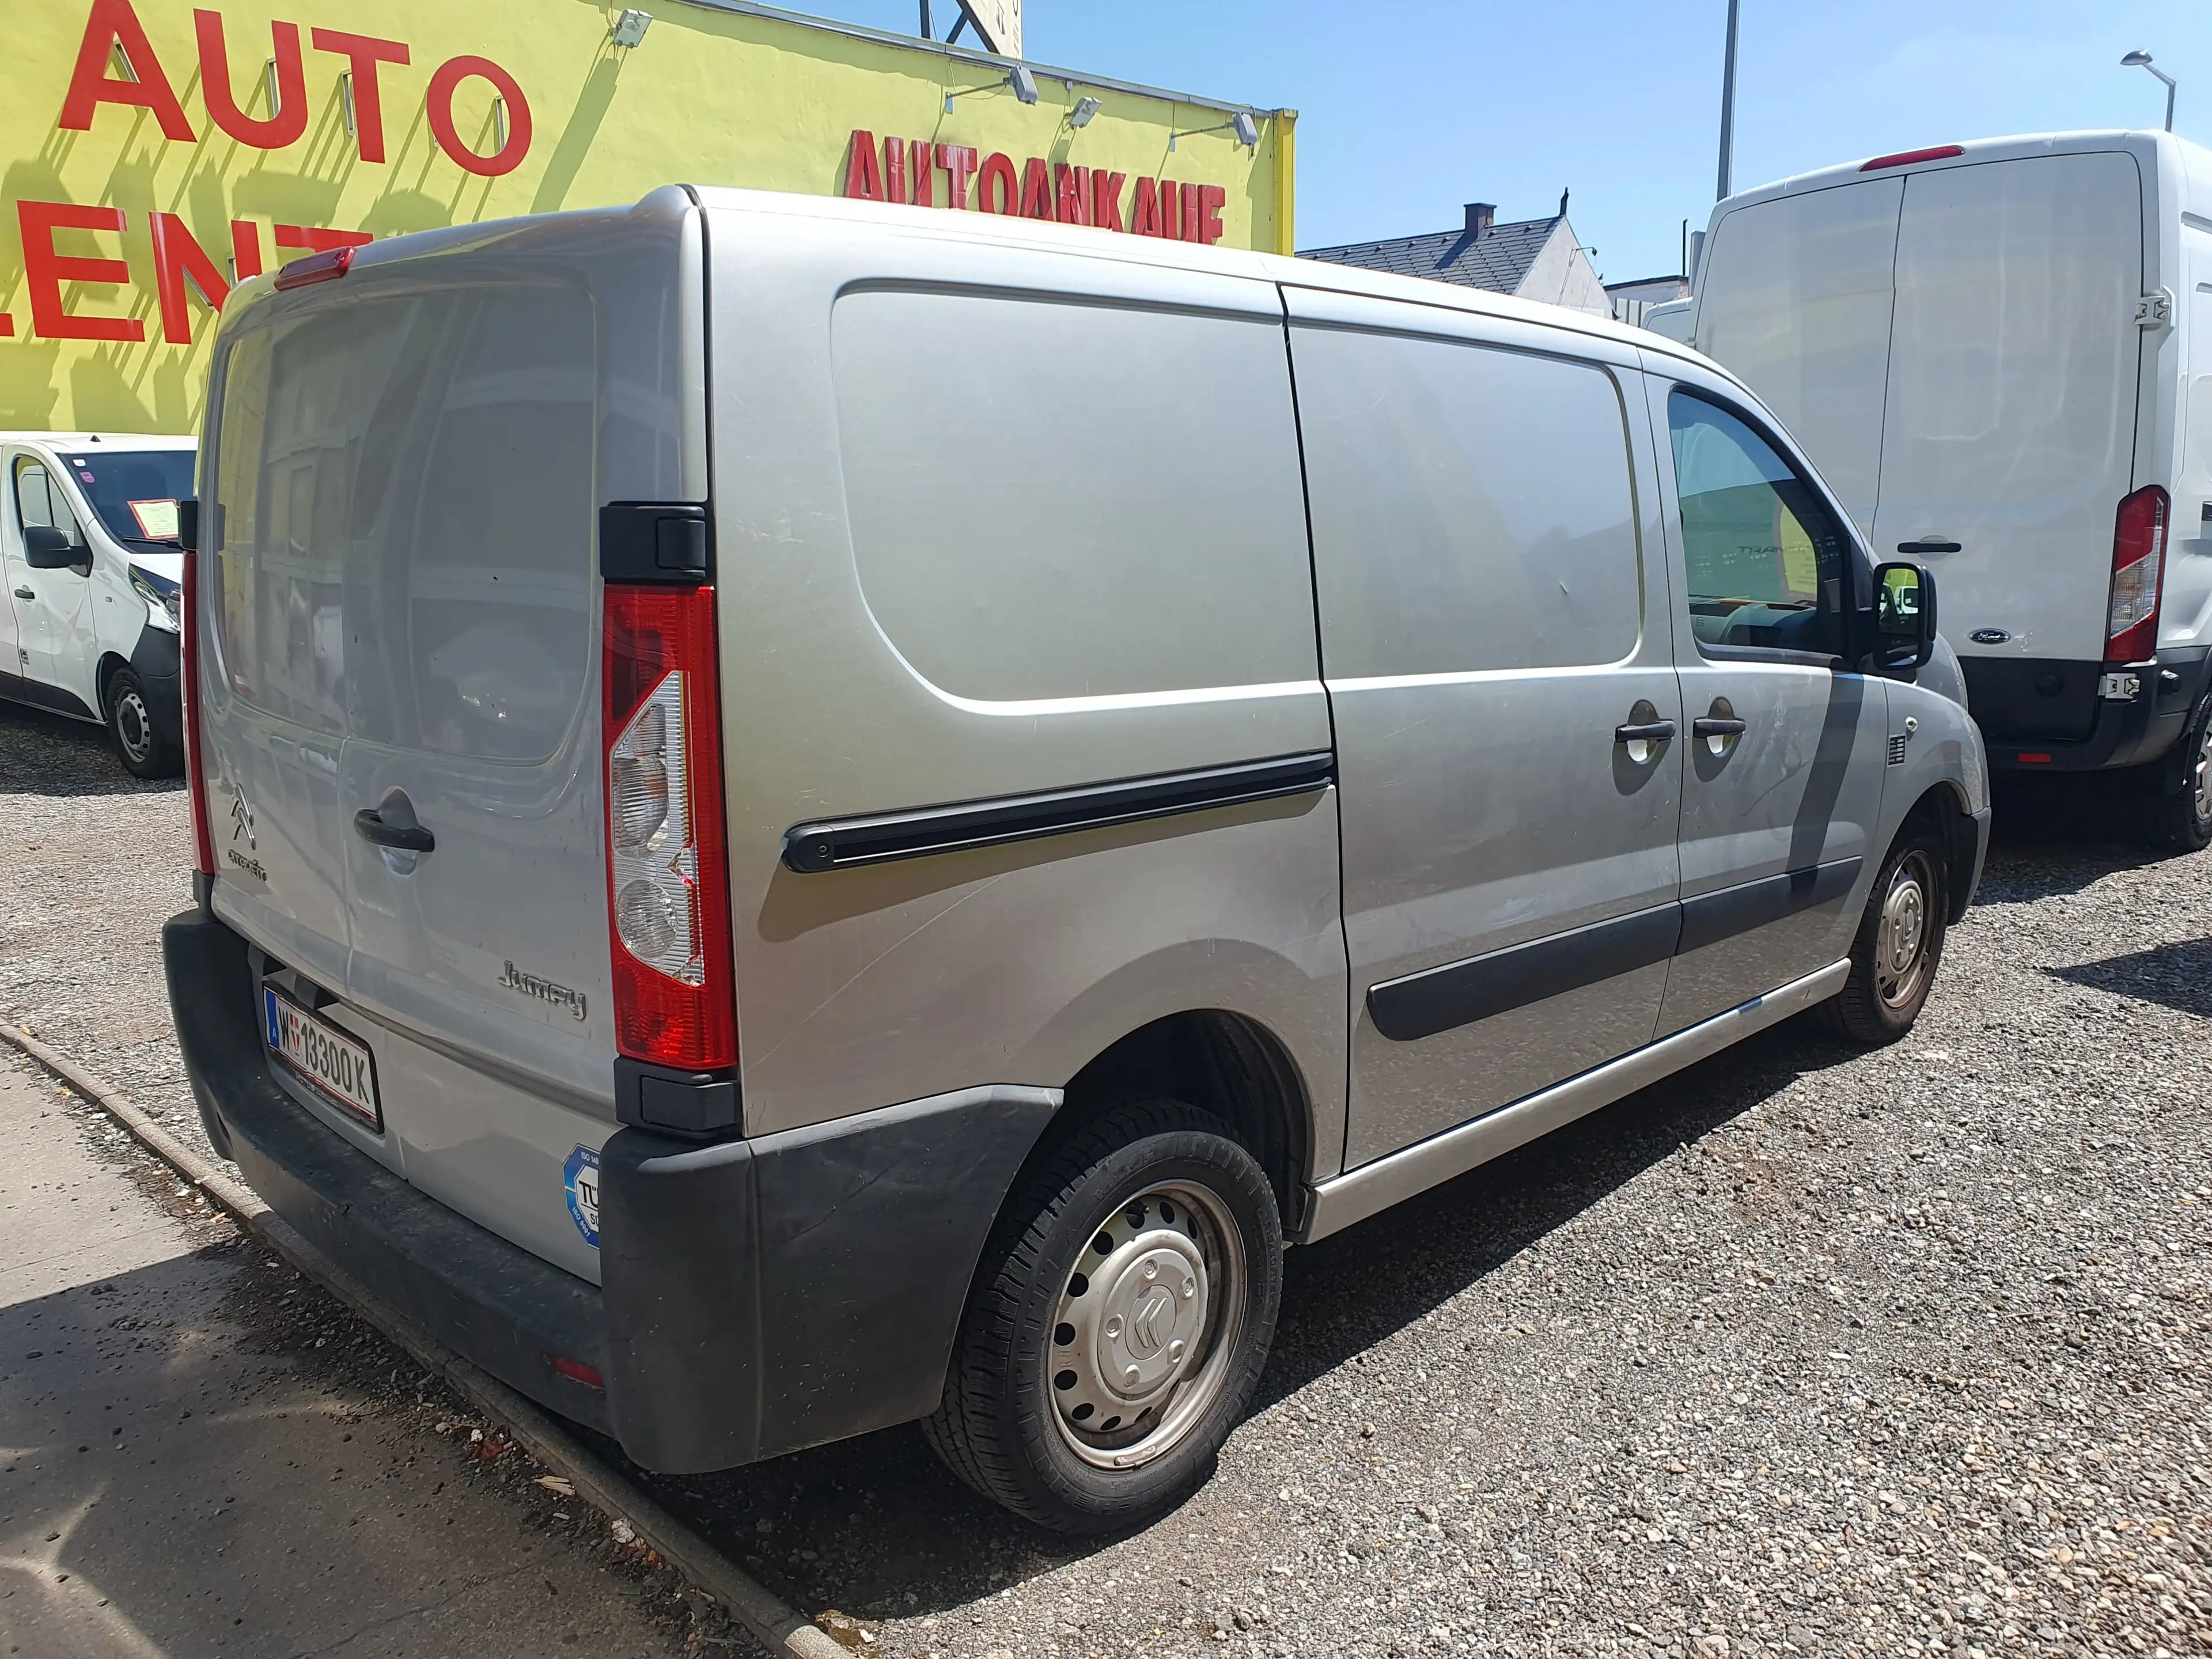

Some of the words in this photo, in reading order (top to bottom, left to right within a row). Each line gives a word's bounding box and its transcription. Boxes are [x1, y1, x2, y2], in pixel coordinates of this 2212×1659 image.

[59, 0, 532, 177] AUTO
[843, 129, 1226, 246] AUTOANKAUF
[497, 959, 588, 1021] Jumpy
[278, 1006, 290, 1051] W
[301, 1022, 353, 1093] 13300
[354, 1055, 370, 1105] K
[581, 1152, 590, 1162] ISO
[571, 1206, 581, 1220] ISO
[579, 1219, 591, 1237] 9001
